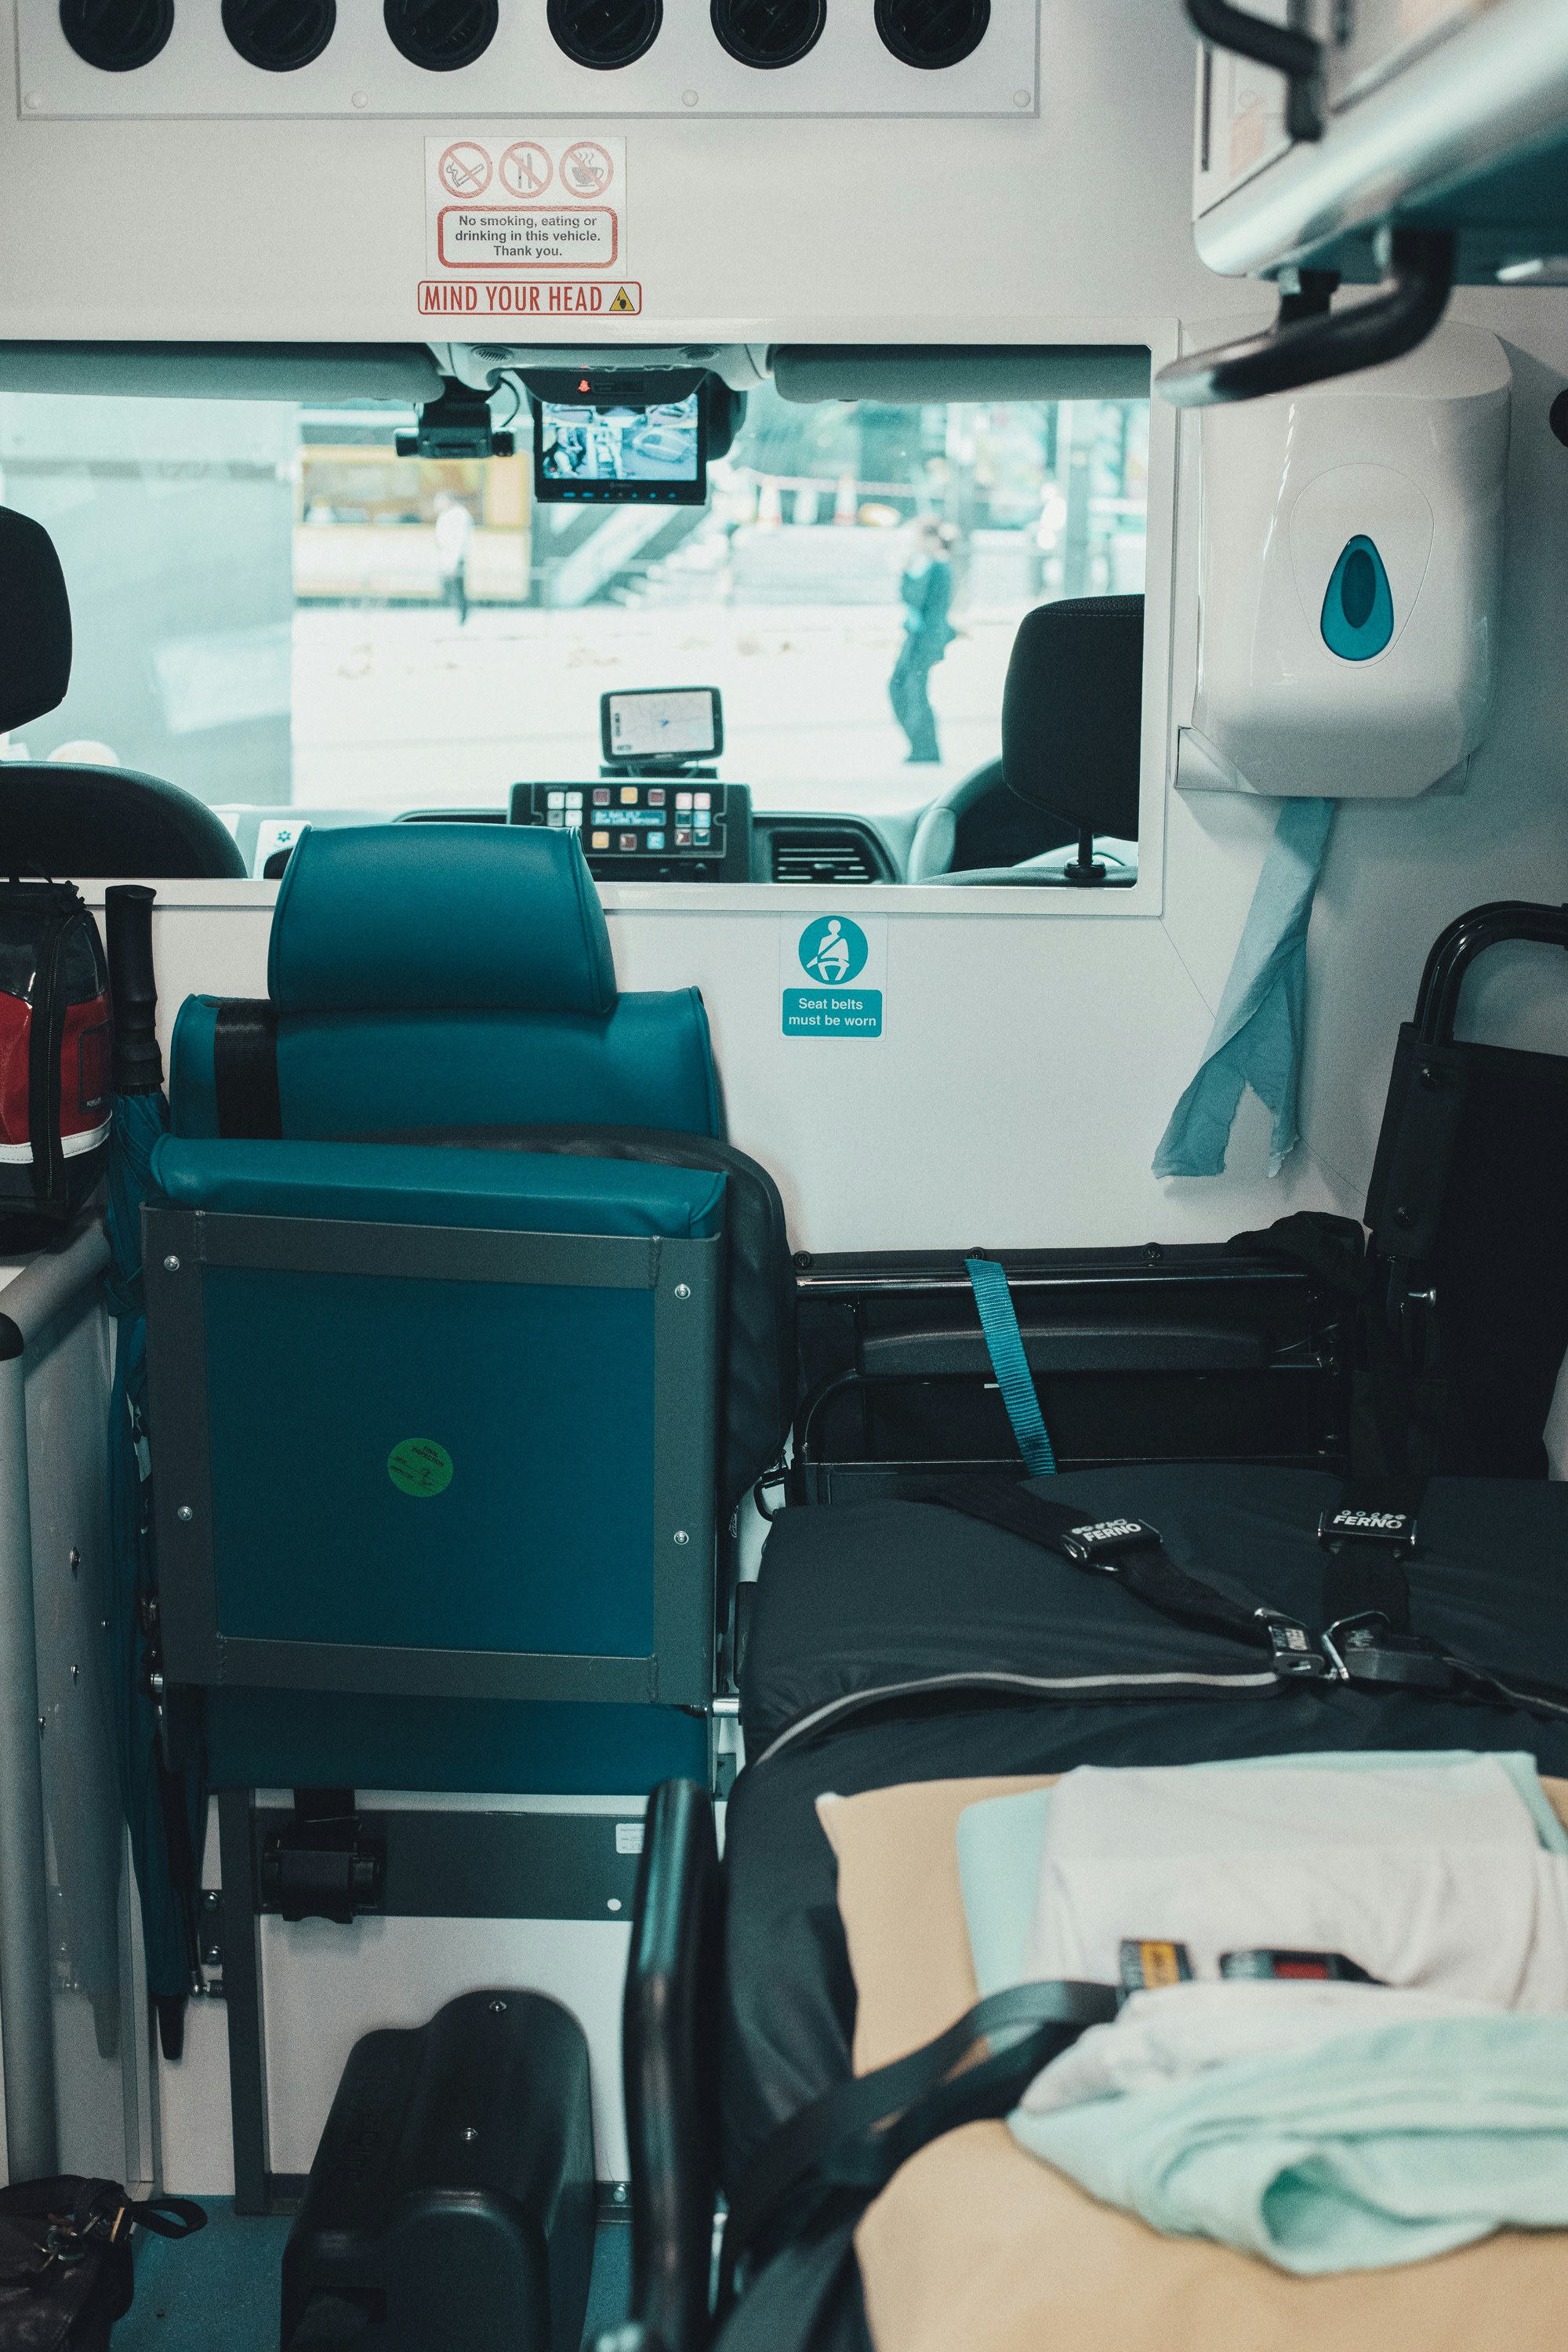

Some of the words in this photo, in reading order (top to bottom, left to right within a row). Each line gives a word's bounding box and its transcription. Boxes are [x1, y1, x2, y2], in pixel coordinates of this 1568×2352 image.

[459, 215, 476, 226] No
[480, 216, 537, 228] smoking,
[541, 216, 580, 228] eating
[583, 217, 597, 226] or
[455, 230, 506, 243] drinking
[511, 230, 522, 241] in
[525, 230, 549, 241] this
[553, 230, 601, 241] vehicle.
[493, 245, 532, 256] Thank
[535, 248, 562, 259] you.
[424, 285, 477, 311] MIND
[485, 285, 540, 311] YOUR
[549, 286, 602, 311] HEAD
[798, 998, 828, 1010] Seat
[831, 999, 863, 1010] belts
[789, 1015, 821, 1025] must
[825, 1015, 840, 1025] be
[844, 1017, 877, 1026] worn
[412, 1446, 445, 1468] INSPECTION
[423, 1446, 438, 1457] FINAL
[390, 1465, 414, 1479] INSPECTOR
[1333, 1515, 1403, 1529] FERNO
[1083, 1523, 1142, 1542] FERNO
